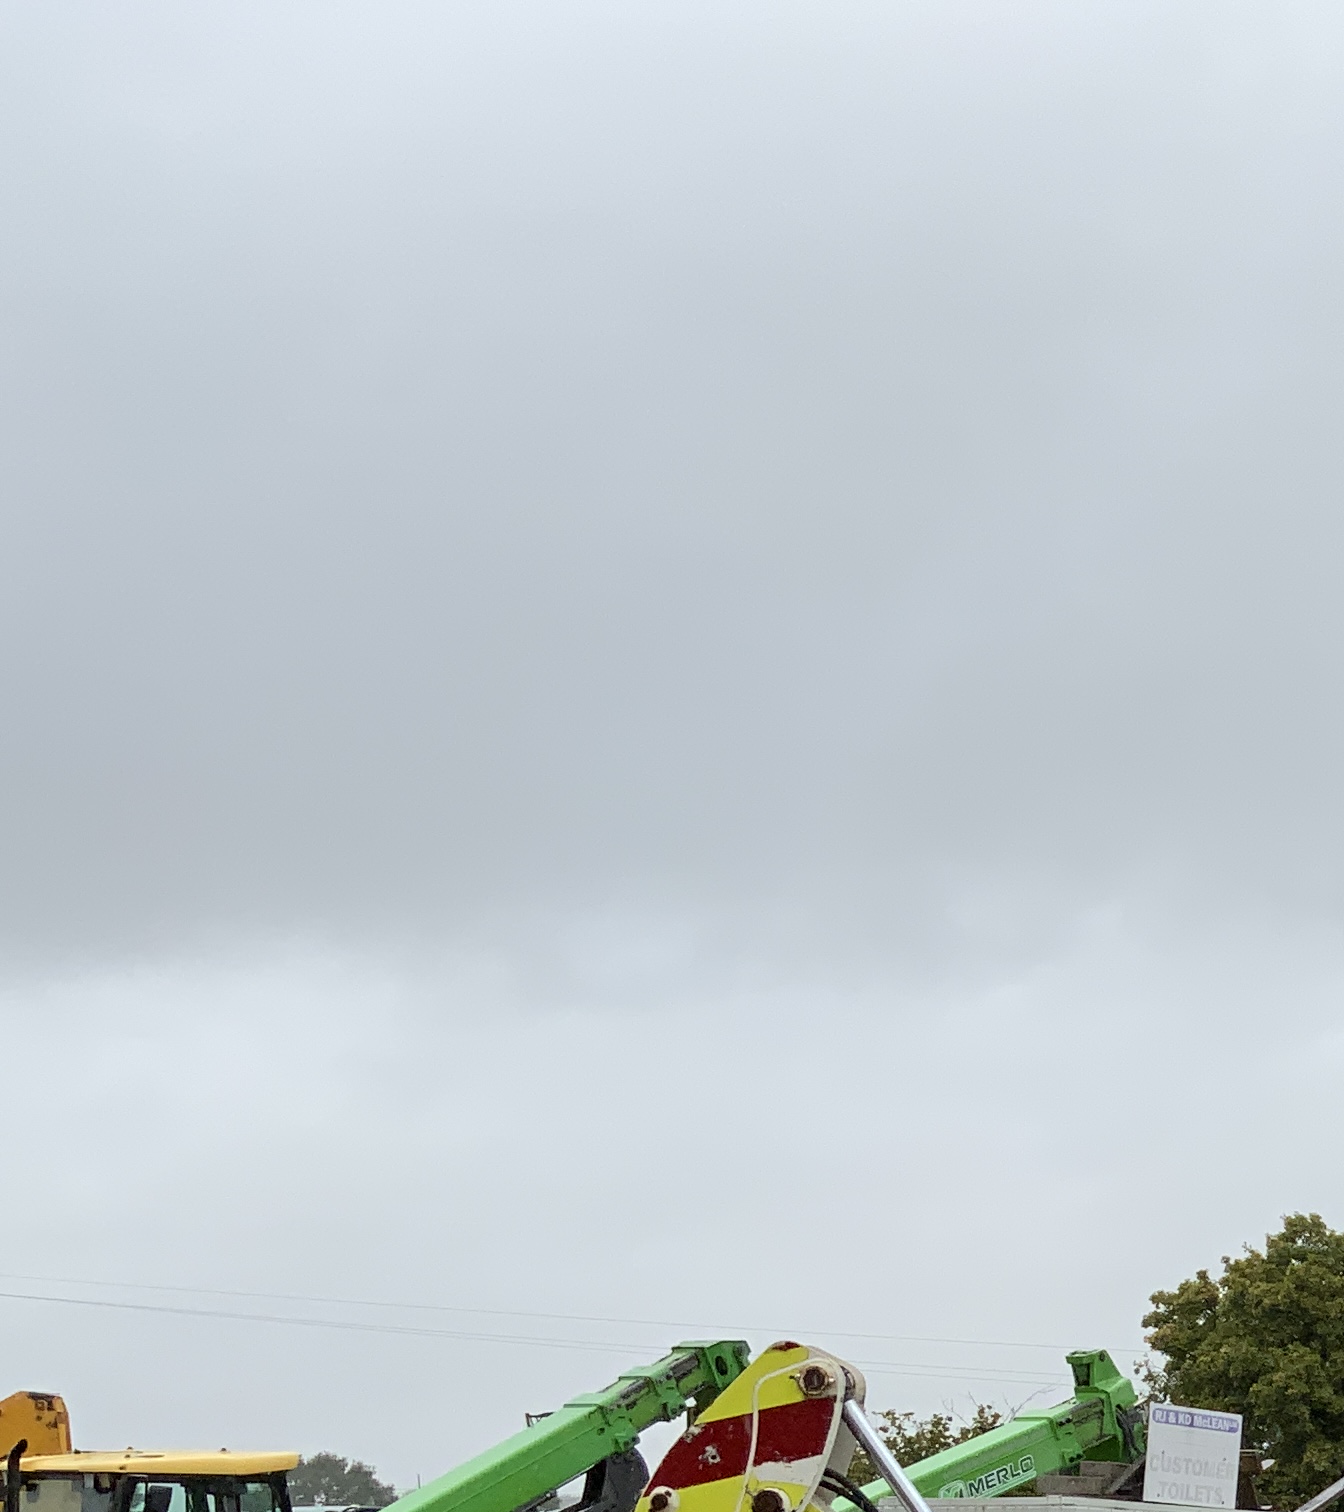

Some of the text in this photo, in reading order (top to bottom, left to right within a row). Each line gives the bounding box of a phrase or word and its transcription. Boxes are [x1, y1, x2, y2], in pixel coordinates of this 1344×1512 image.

[1178, 1413, 1192, 1426] KD
[967, 1455, 1034, 1497] MERLO
[1158, 1481, 1223, 1504] TOILETS
